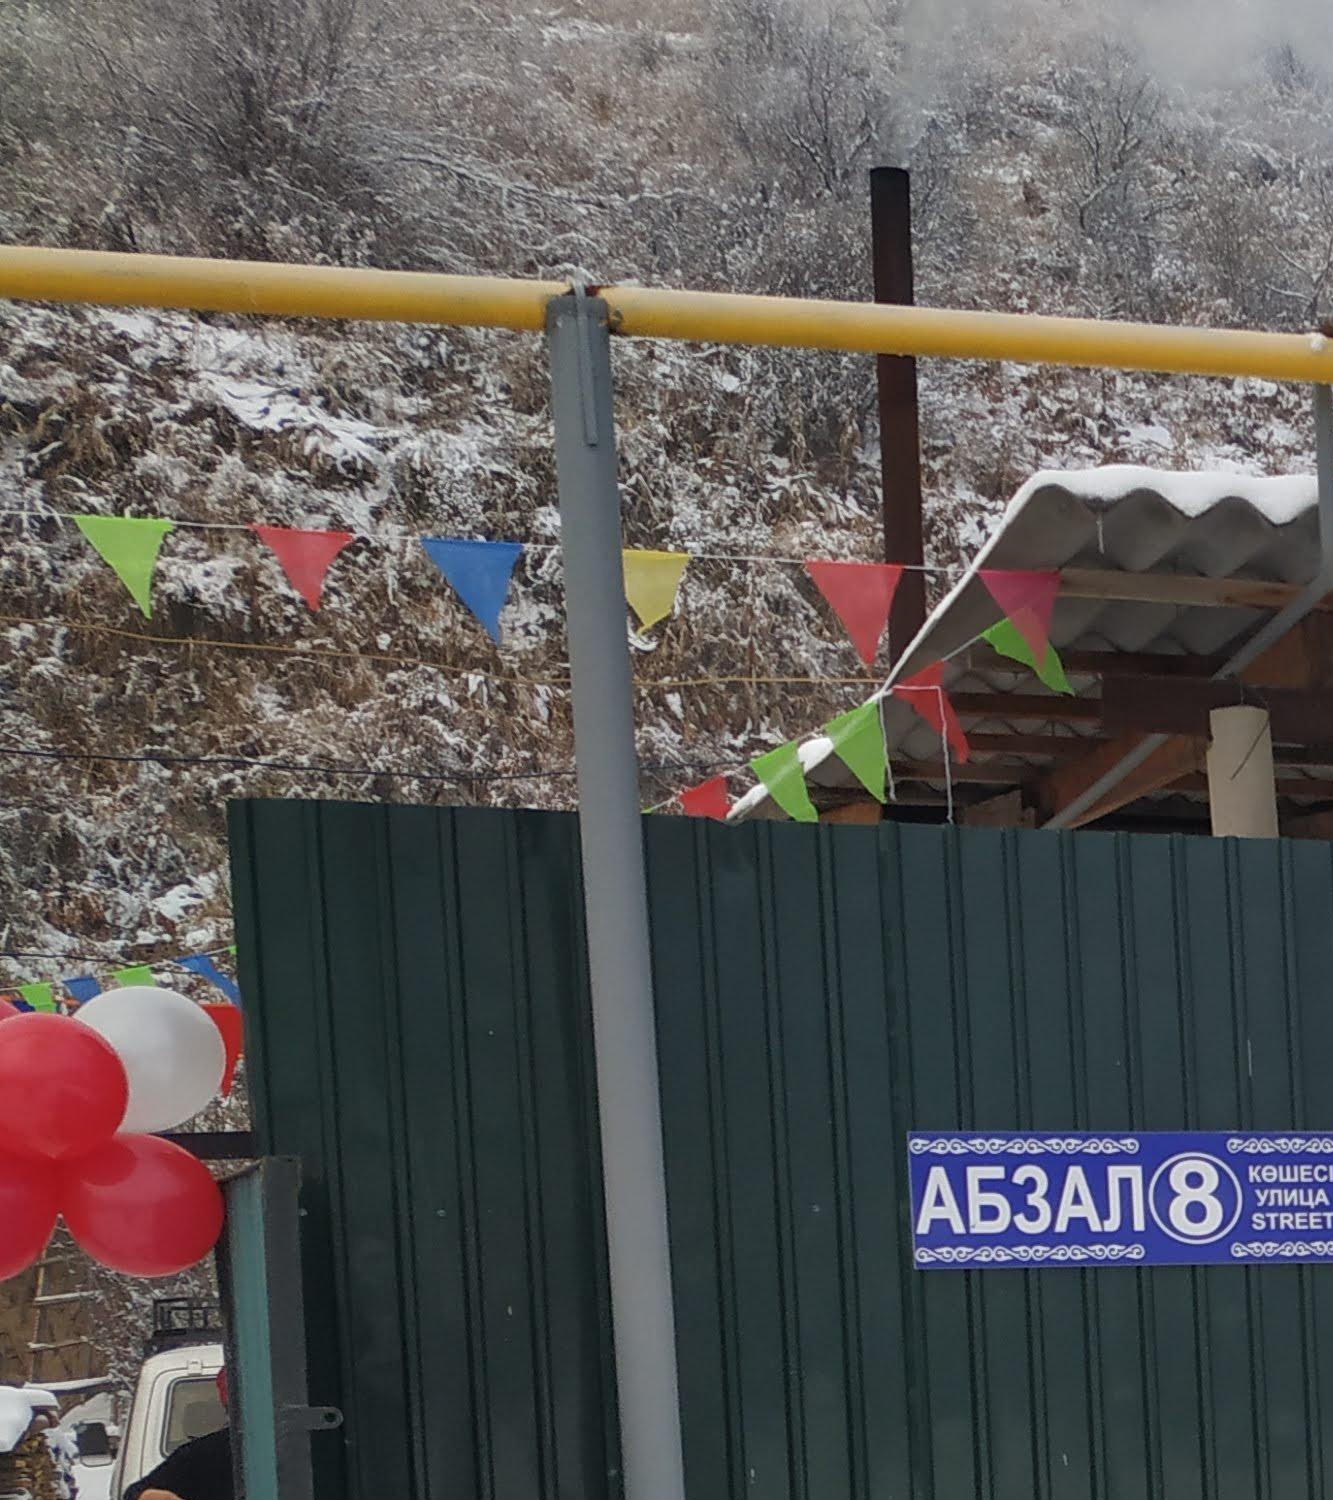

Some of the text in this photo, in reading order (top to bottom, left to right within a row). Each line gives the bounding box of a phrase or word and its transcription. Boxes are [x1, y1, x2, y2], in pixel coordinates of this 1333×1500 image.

[915, 1159, 1223, 1236] АБЗАЛ 8
[1255, 1187, 1330, 1208] УЛИЦА
